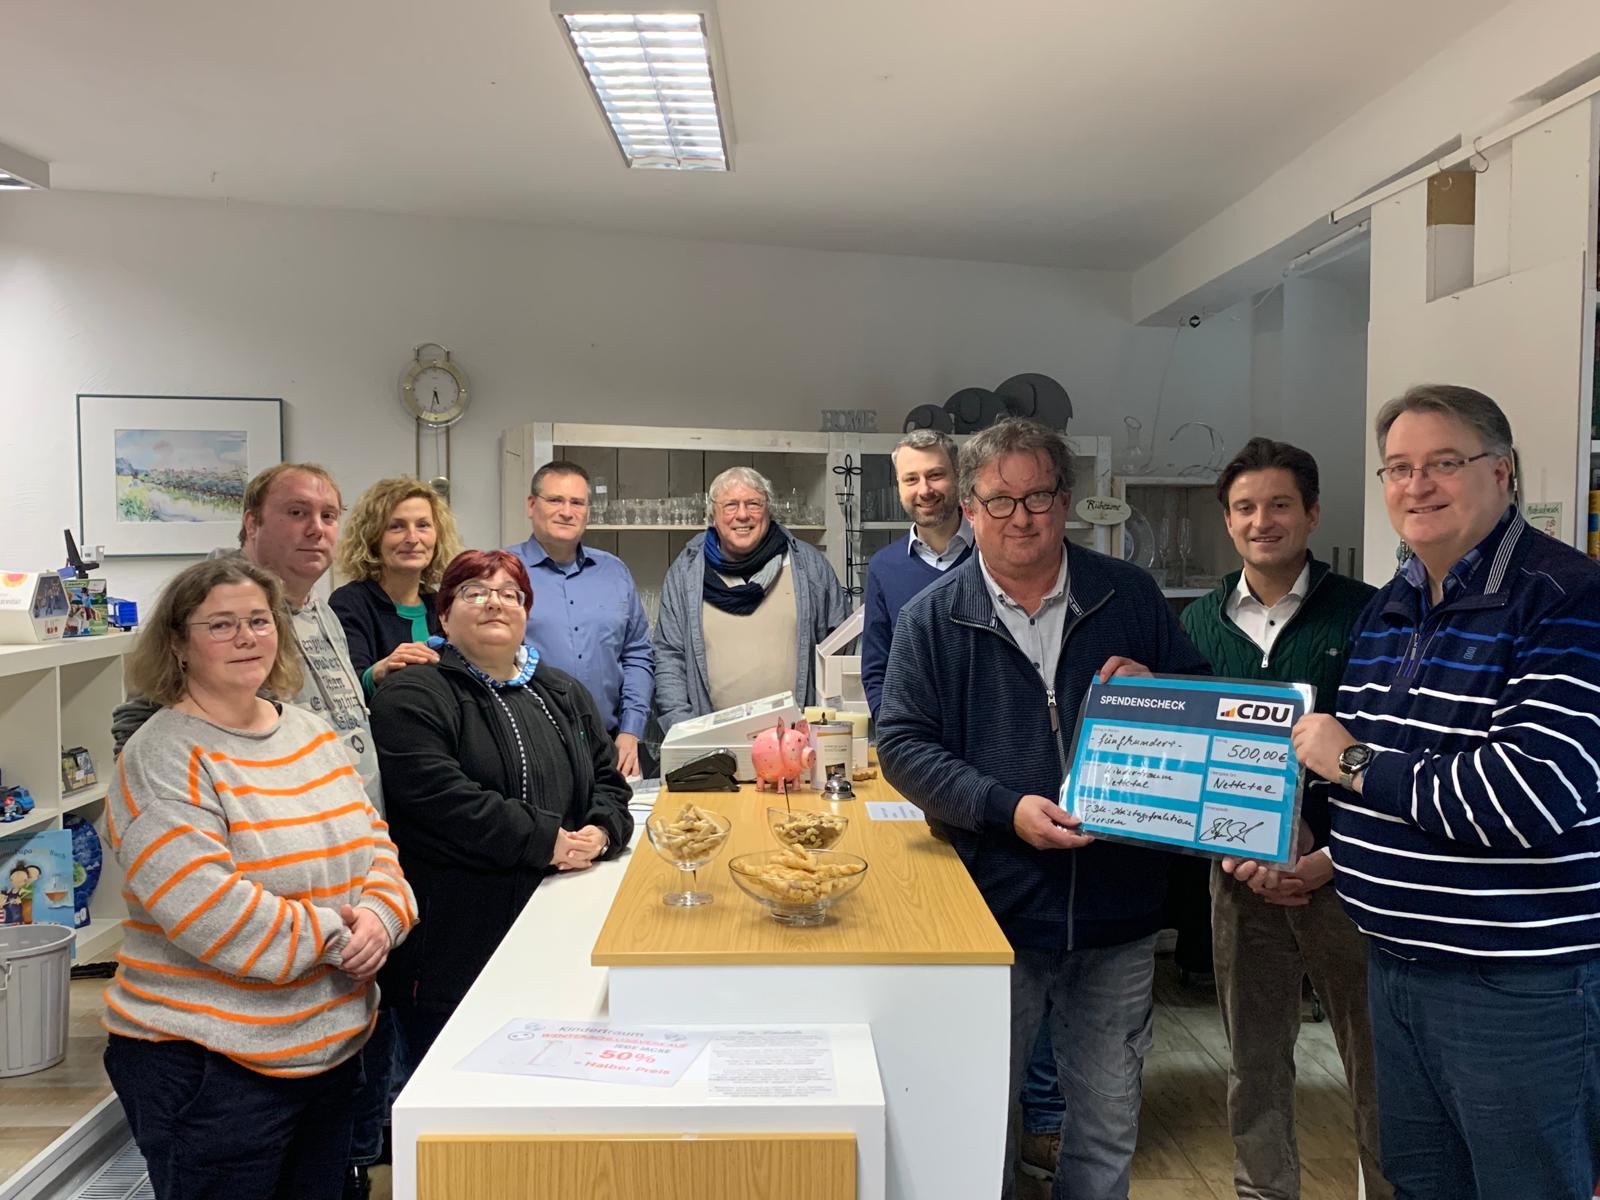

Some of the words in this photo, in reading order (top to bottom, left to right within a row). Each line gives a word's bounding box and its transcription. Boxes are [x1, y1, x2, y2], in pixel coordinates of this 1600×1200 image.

[820, 408, 878, 432] HOME
[1100, 695, 1186, 711] SPENDENSCHECK
[1237, 703, 1290, 722] CDU
[1227, 744, 1288, 763] 500,00€
[1213, 777, 1276, 795] Nettetal
[559, 1026, 644, 1037] Kindertraum
[599, 1049, 656, 1064] 50%
